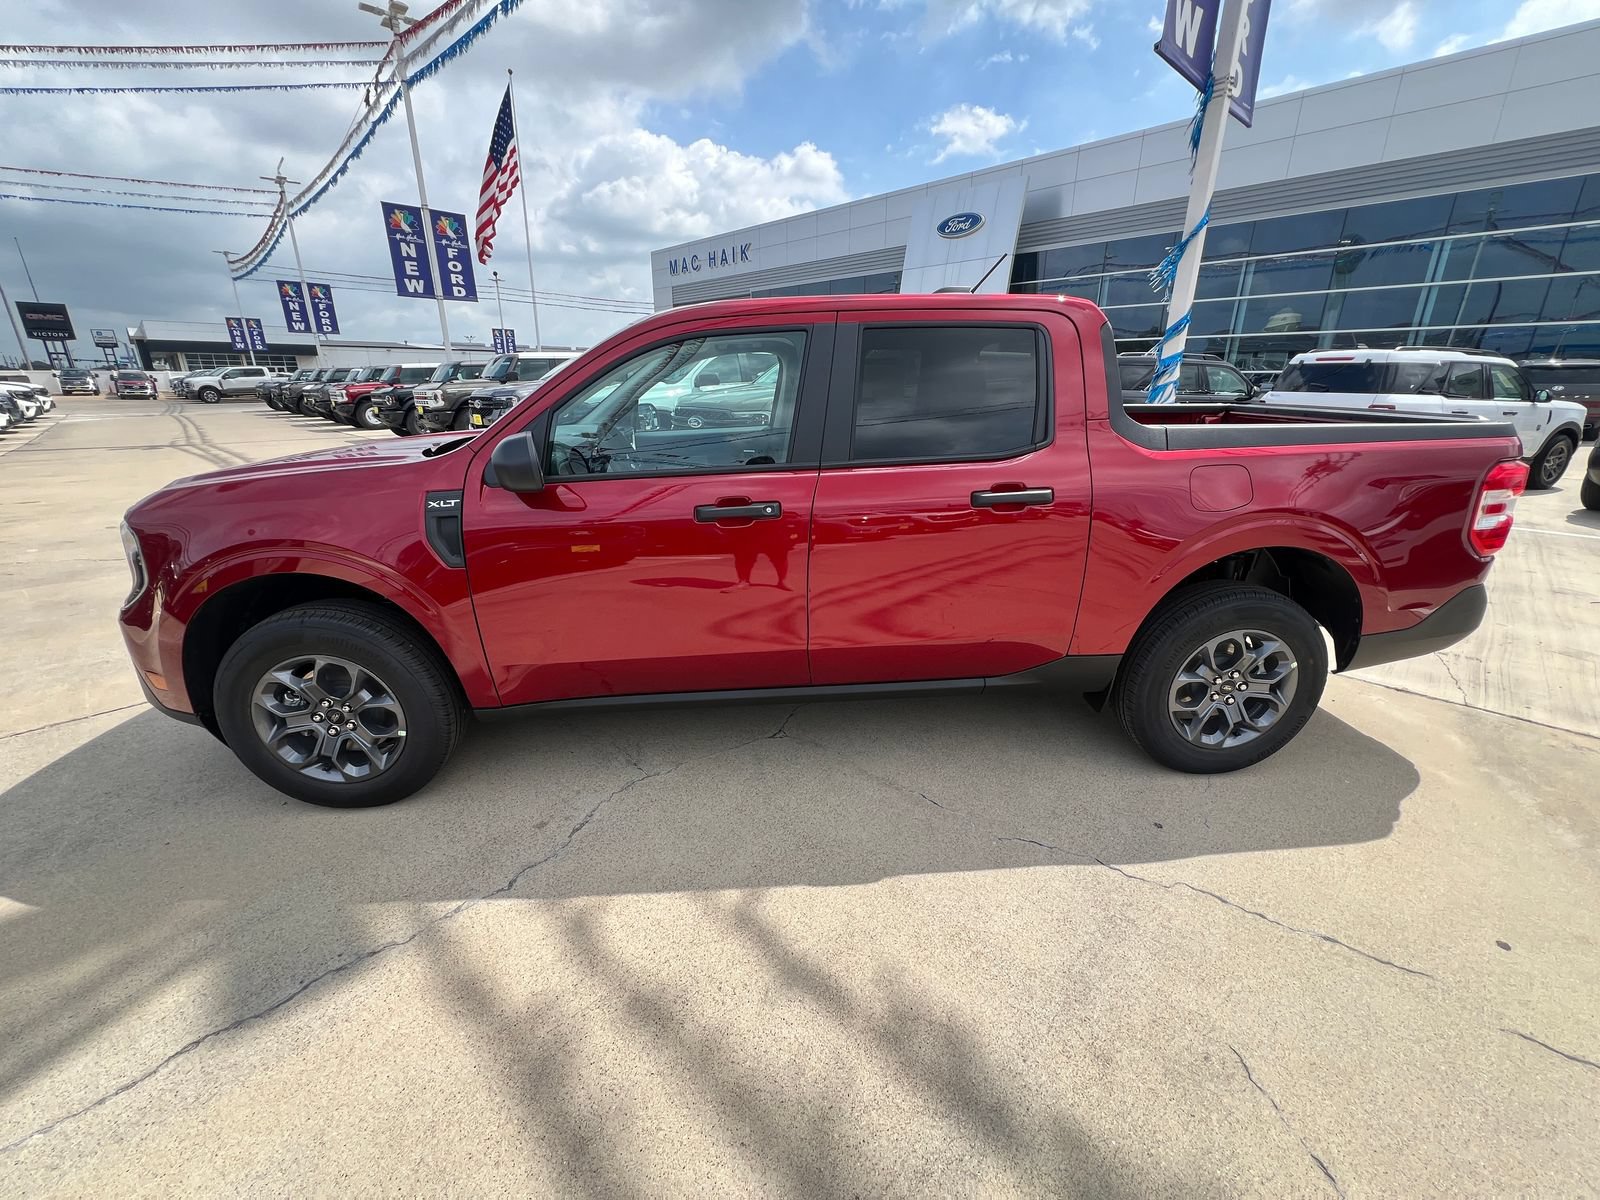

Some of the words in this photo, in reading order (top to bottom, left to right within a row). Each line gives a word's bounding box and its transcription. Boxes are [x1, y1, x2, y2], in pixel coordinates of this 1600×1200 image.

[944, 216, 973, 233] Ford
[400, 242, 425, 294] NEW
[446, 247, 467, 297] FORD
[669, 254, 700, 275] MAC
[708, 242, 750, 268] HAIK
[288, 301, 305, 331] NEW
[318, 303, 332, 332] FORD
[233, 330, 245, 349] NEW
[253, 330, 263, 350] FORD
[428, 499, 460, 508] XLT
